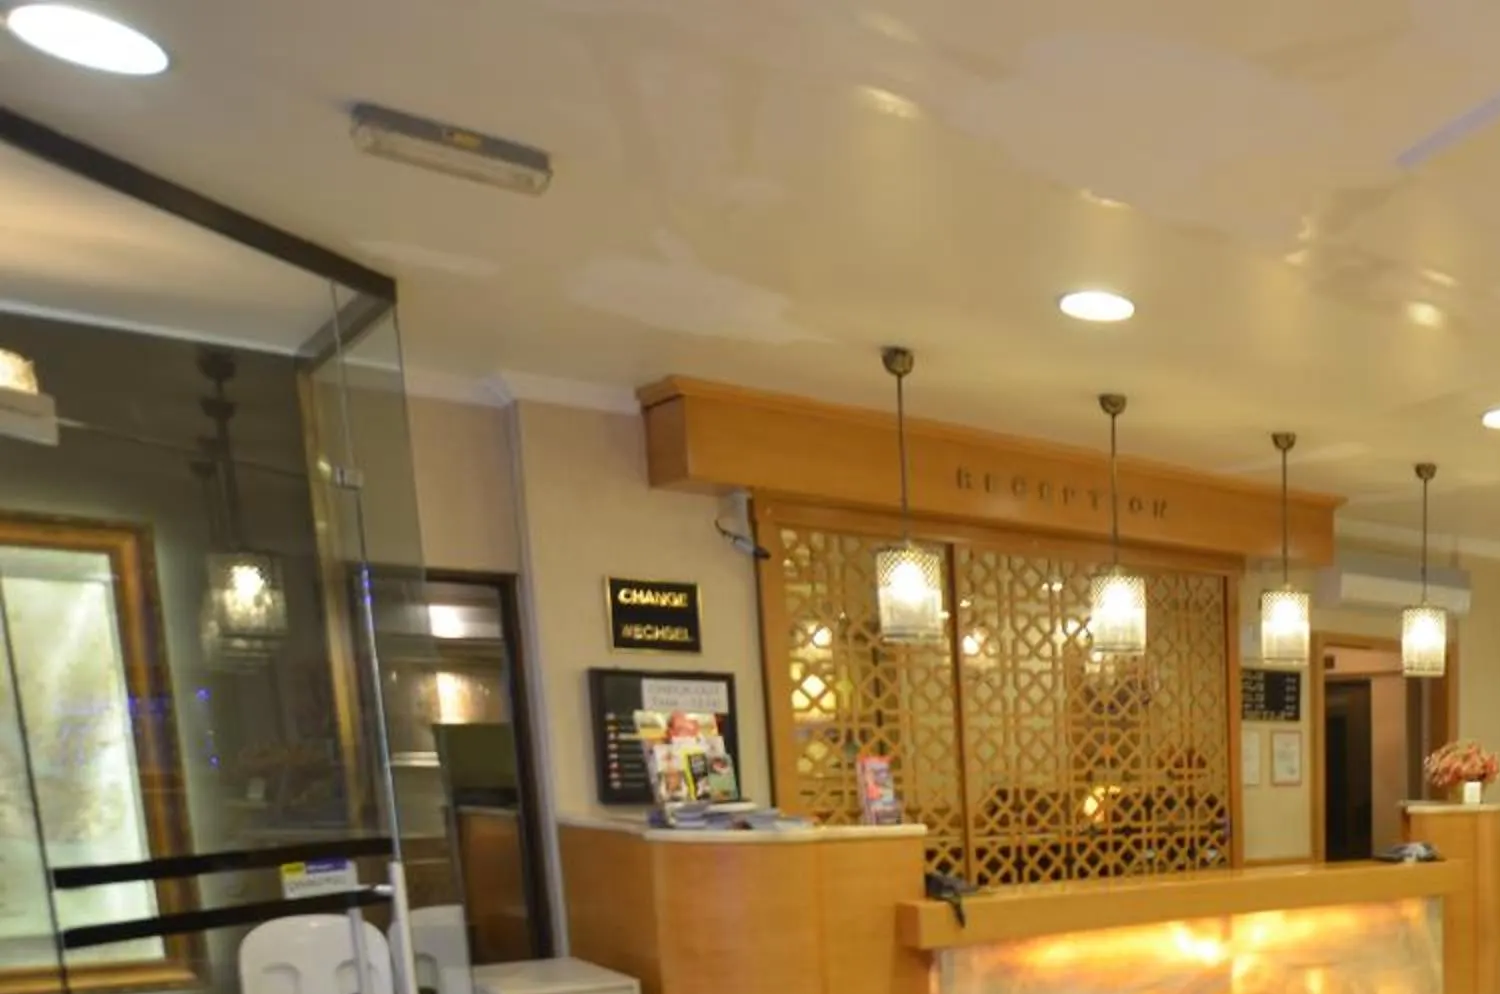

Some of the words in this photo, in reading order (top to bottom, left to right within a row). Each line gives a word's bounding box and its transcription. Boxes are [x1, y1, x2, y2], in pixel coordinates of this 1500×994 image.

[955, 466, 1168, 520] RECEPTON
[618, 587, 689, 607] CHANGE
[621, 623, 693, 642] WECHSEL
